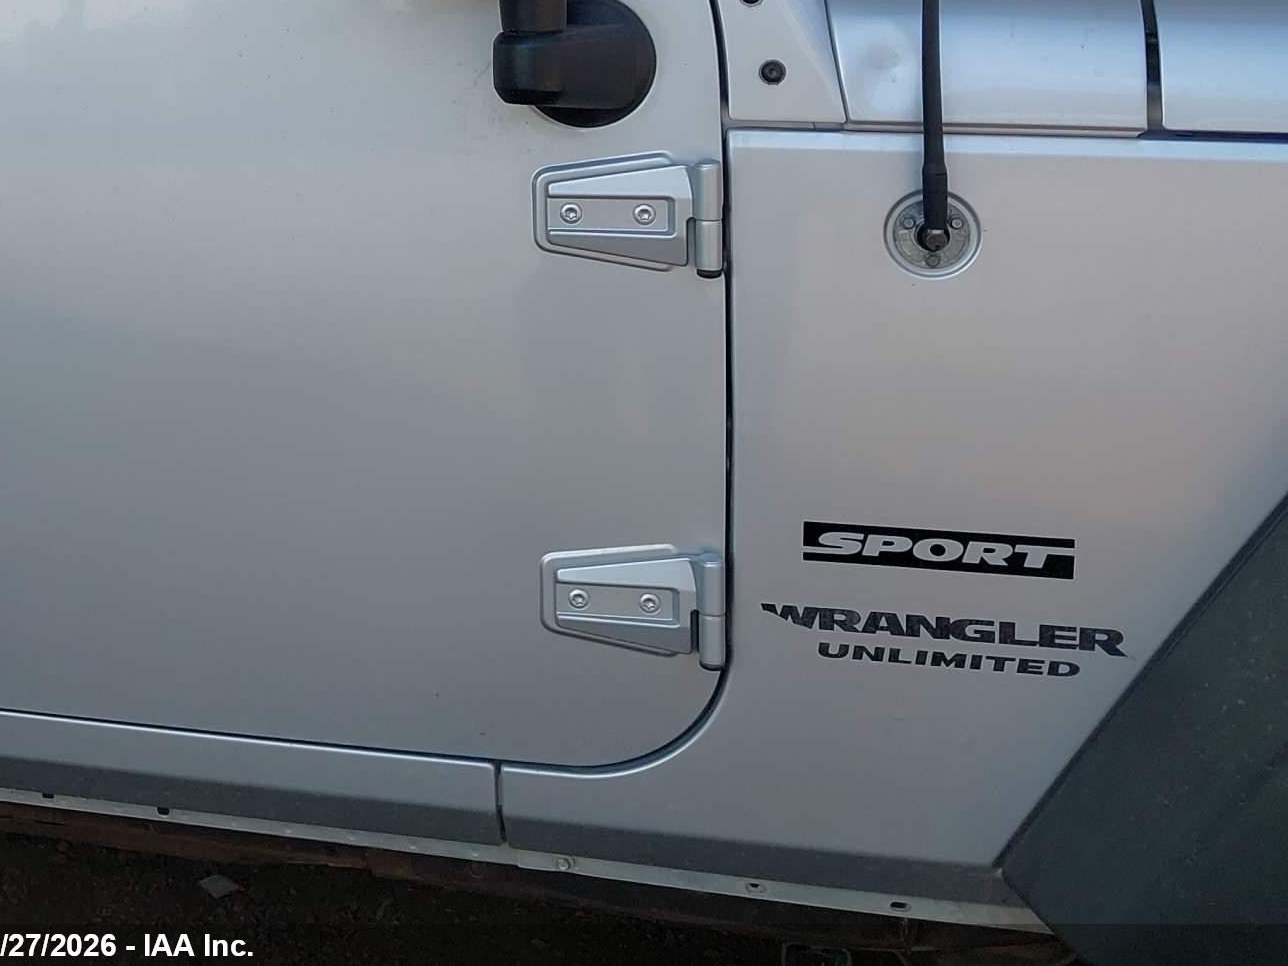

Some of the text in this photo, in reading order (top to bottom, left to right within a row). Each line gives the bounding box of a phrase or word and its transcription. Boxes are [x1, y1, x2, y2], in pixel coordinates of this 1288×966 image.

[812, 530, 1074, 570] SPORT
[760, 602, 1129, 658] WRANGLER
[818, 641, 1080, 677] UNLIMITED
